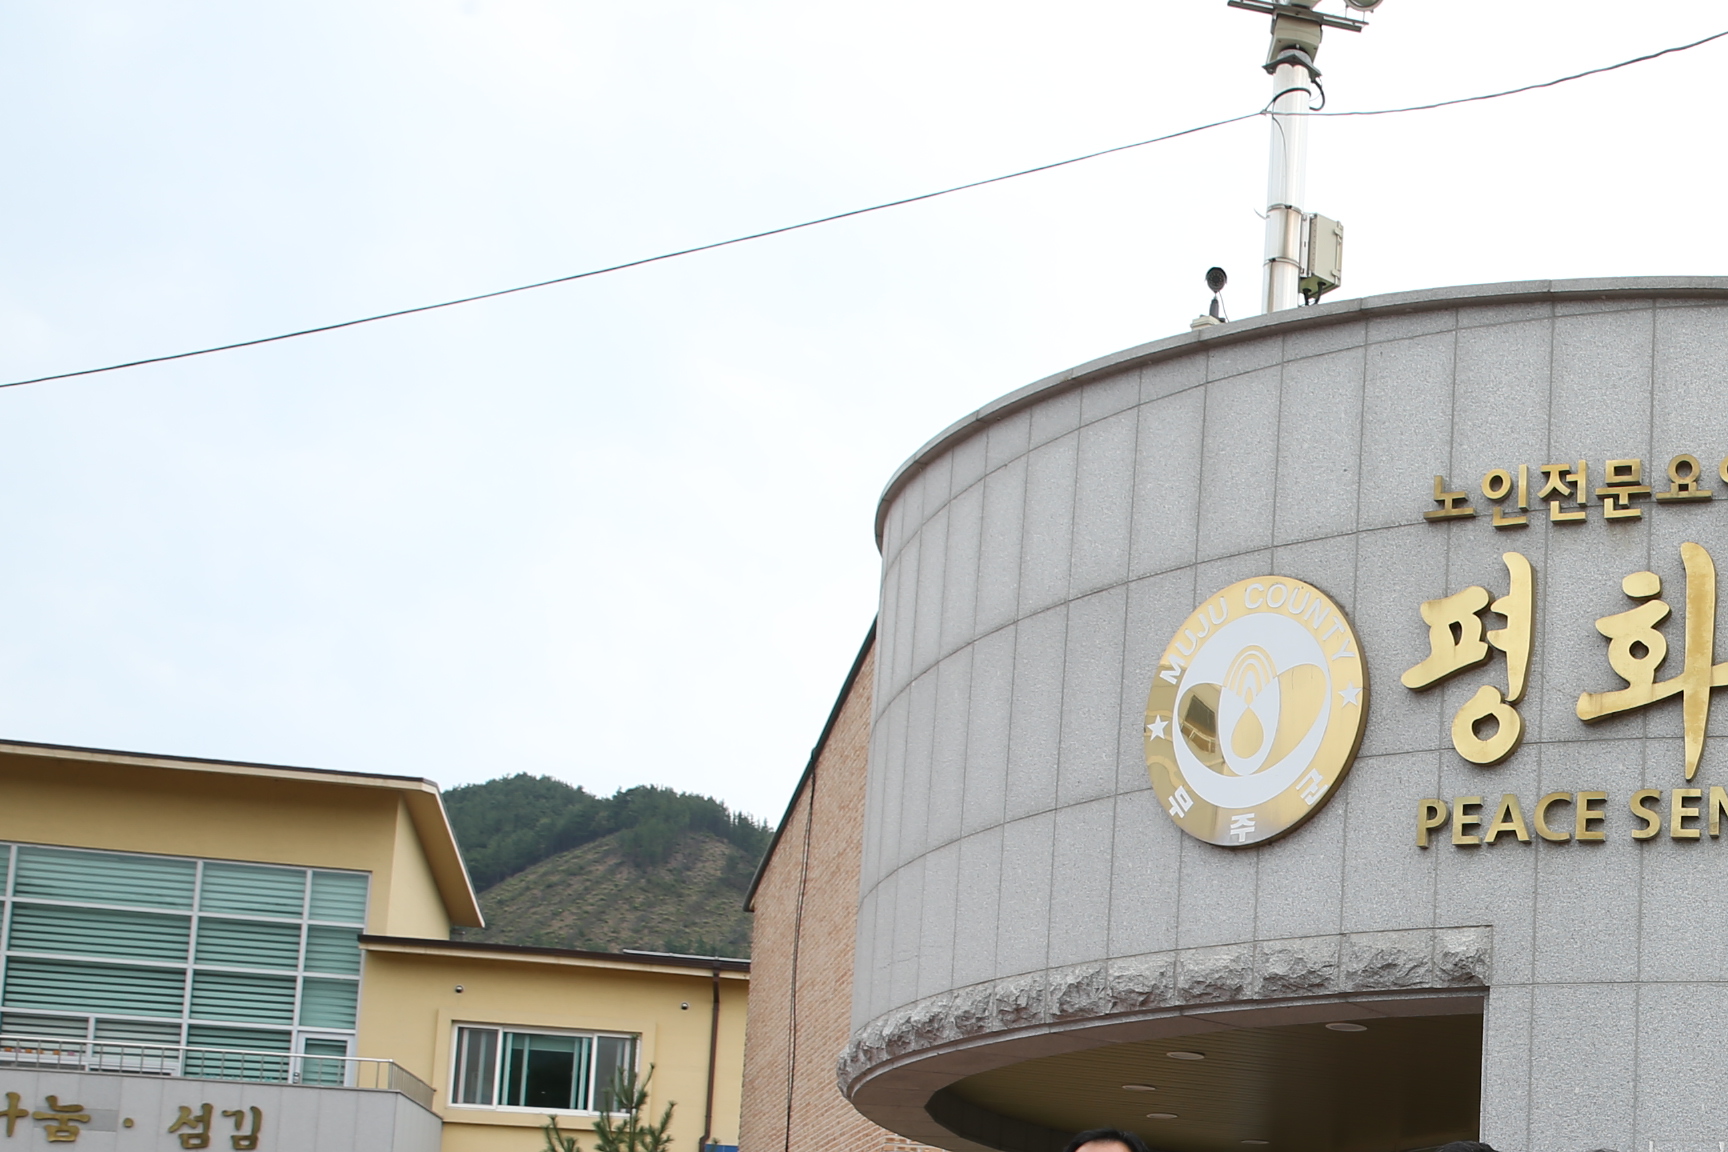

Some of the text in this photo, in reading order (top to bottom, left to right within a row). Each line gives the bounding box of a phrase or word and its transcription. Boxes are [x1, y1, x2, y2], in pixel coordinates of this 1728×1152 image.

[1159, 583, 1356, 685] MUJU COUNTY
[1416, 790, 1608, 849] PEACE
[168, 1102, 263, 1151] 섬김
